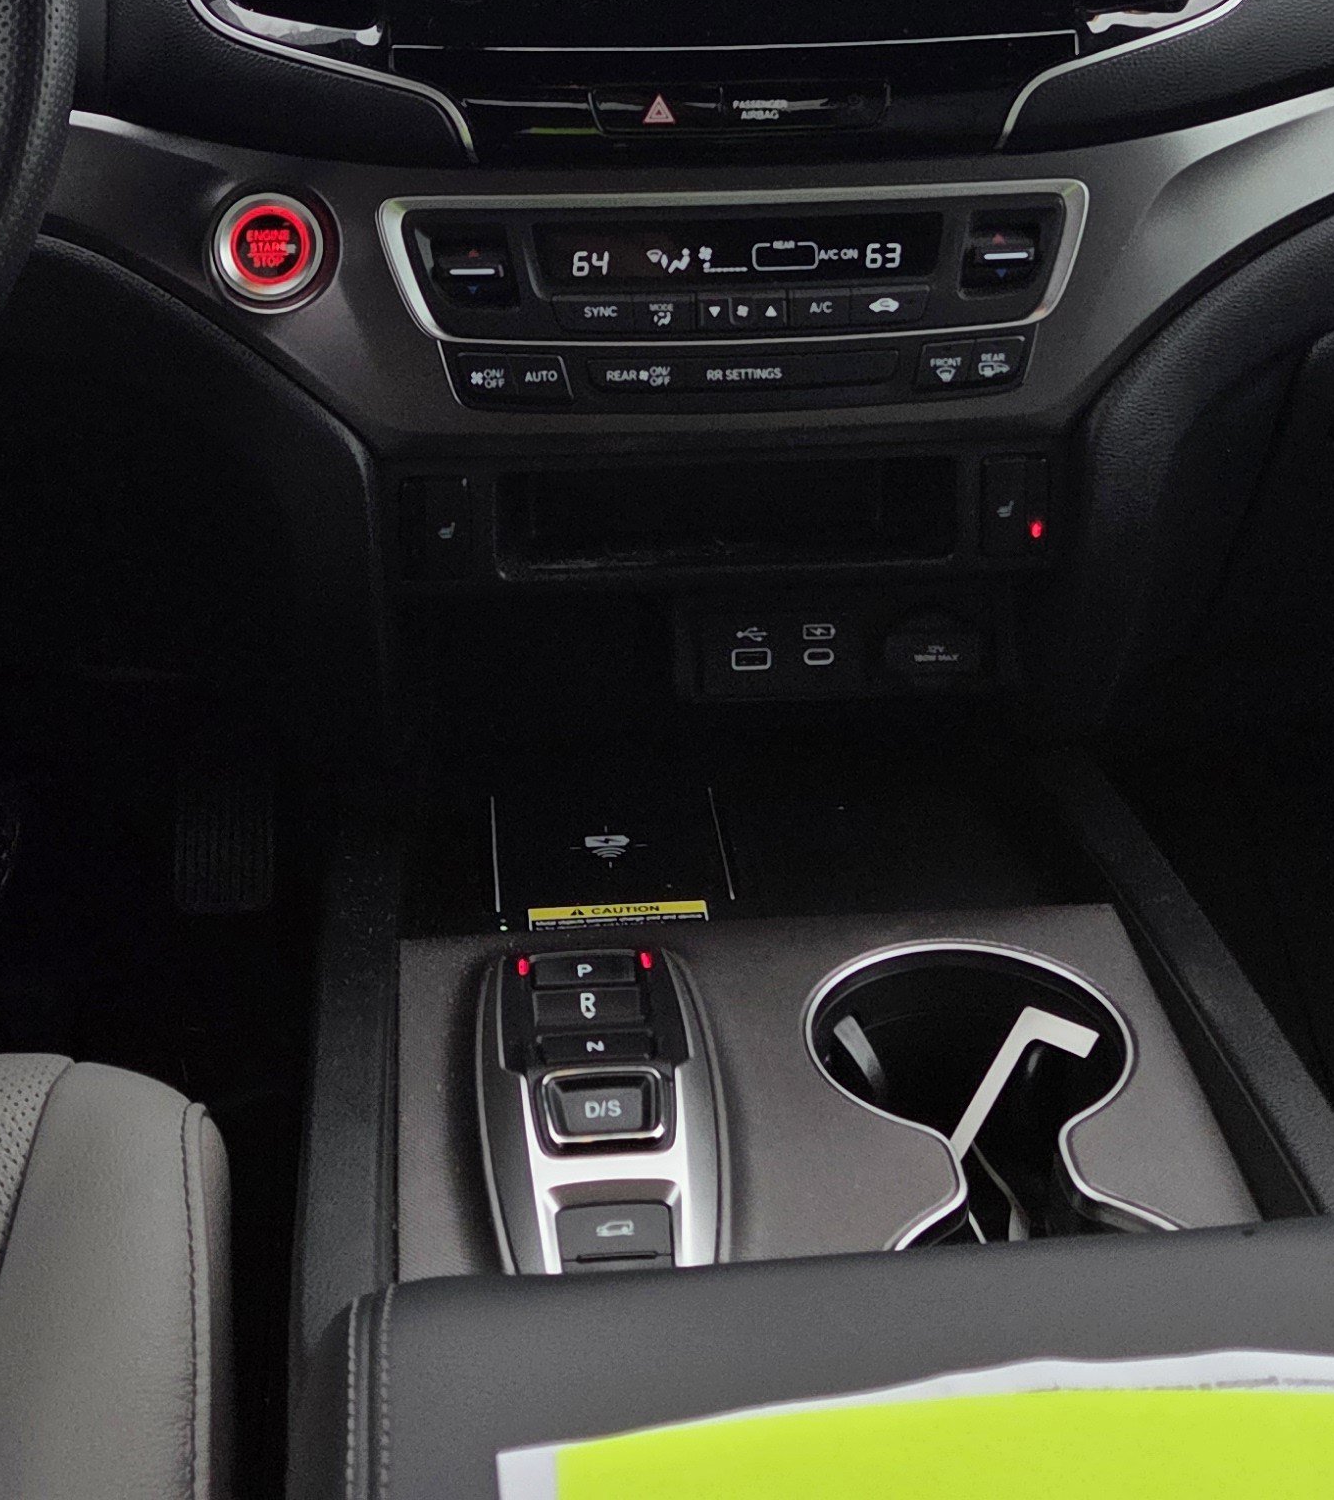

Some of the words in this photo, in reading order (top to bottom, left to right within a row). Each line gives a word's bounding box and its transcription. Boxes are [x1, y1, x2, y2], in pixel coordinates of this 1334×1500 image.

[246, 229, 290, 243] ENGINE
[772, 239, 796, 249] REAR
[818, 249, 839, 260] A/C
[840, 248, 858, 260] ON
[865, 242, 902, 269] 63
[253, 257, 285, 268] STOP
[572, 250, 610, 277] 64
[583, 305, 618, 318] SYNC
[649, 303, 674, 312] MODE
[809, 301, 833, 313] A/C
[930, 357, 961, 367] FRONT
[980, 353, 1006, 361] REAR
[524, 371, 558, 383] AUTO
[606, 370, 638, 381] REAR
[706, 369, 723, 380] RR
[725, 368, 782, 381] SETTINGS
[484, 378, 505, 388] OFF
[649, 376, 670, 386] OFF
[591, 904, 660, 916] CAUTION
[577, 963, 593, 977] P
[580, 992, 596, 1013] R
[586, 1040, 605, 1052] N
[584, 1099, 622, 1118] D/S
